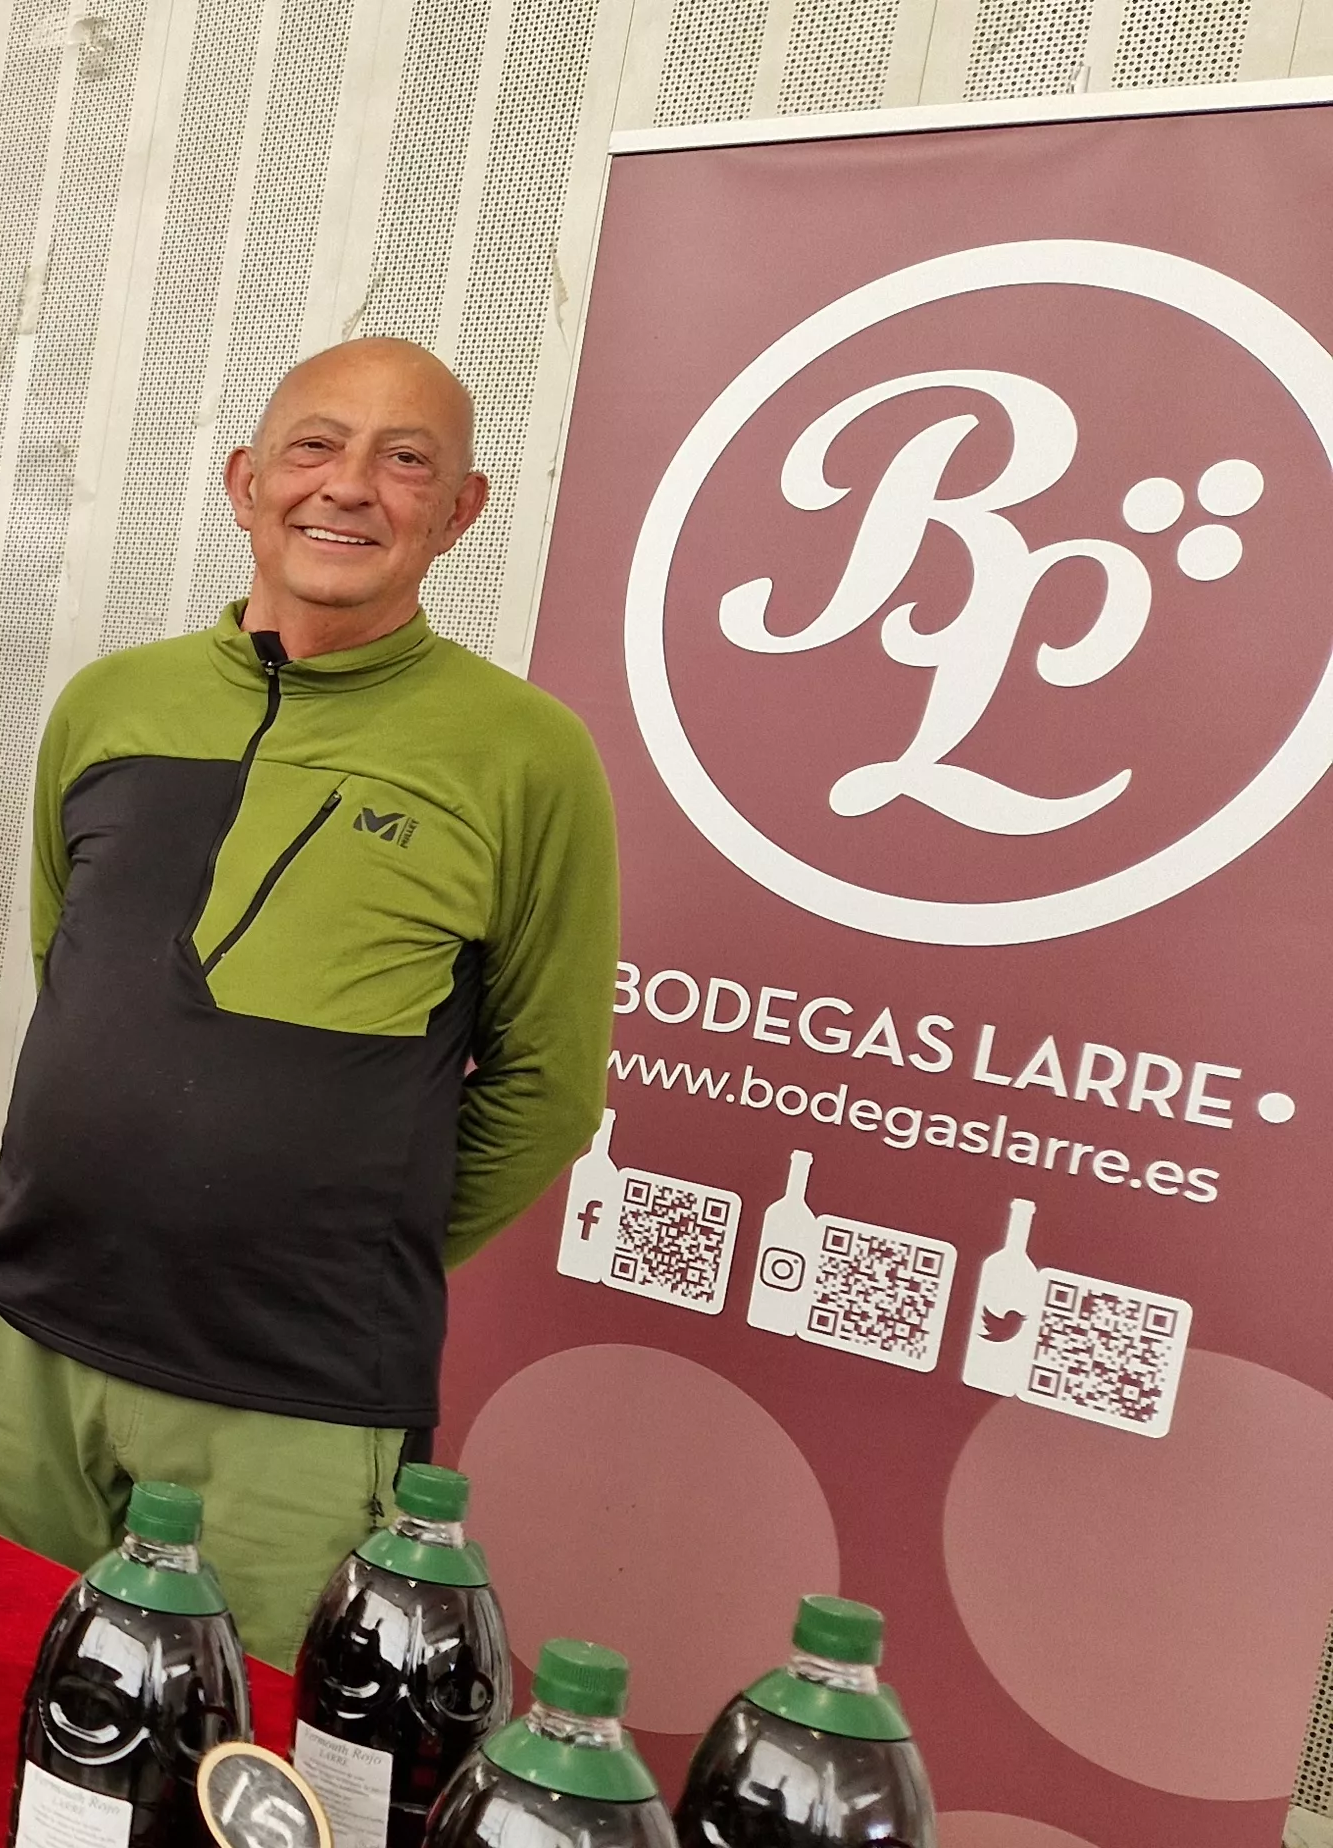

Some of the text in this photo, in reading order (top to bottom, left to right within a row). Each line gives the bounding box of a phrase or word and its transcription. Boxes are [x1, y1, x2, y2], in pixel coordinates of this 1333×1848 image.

[613, 960, 1242, 1130] BODEGAS LARRE
[607, 1049, 1220, 1204] www.bodegaslarre.es
